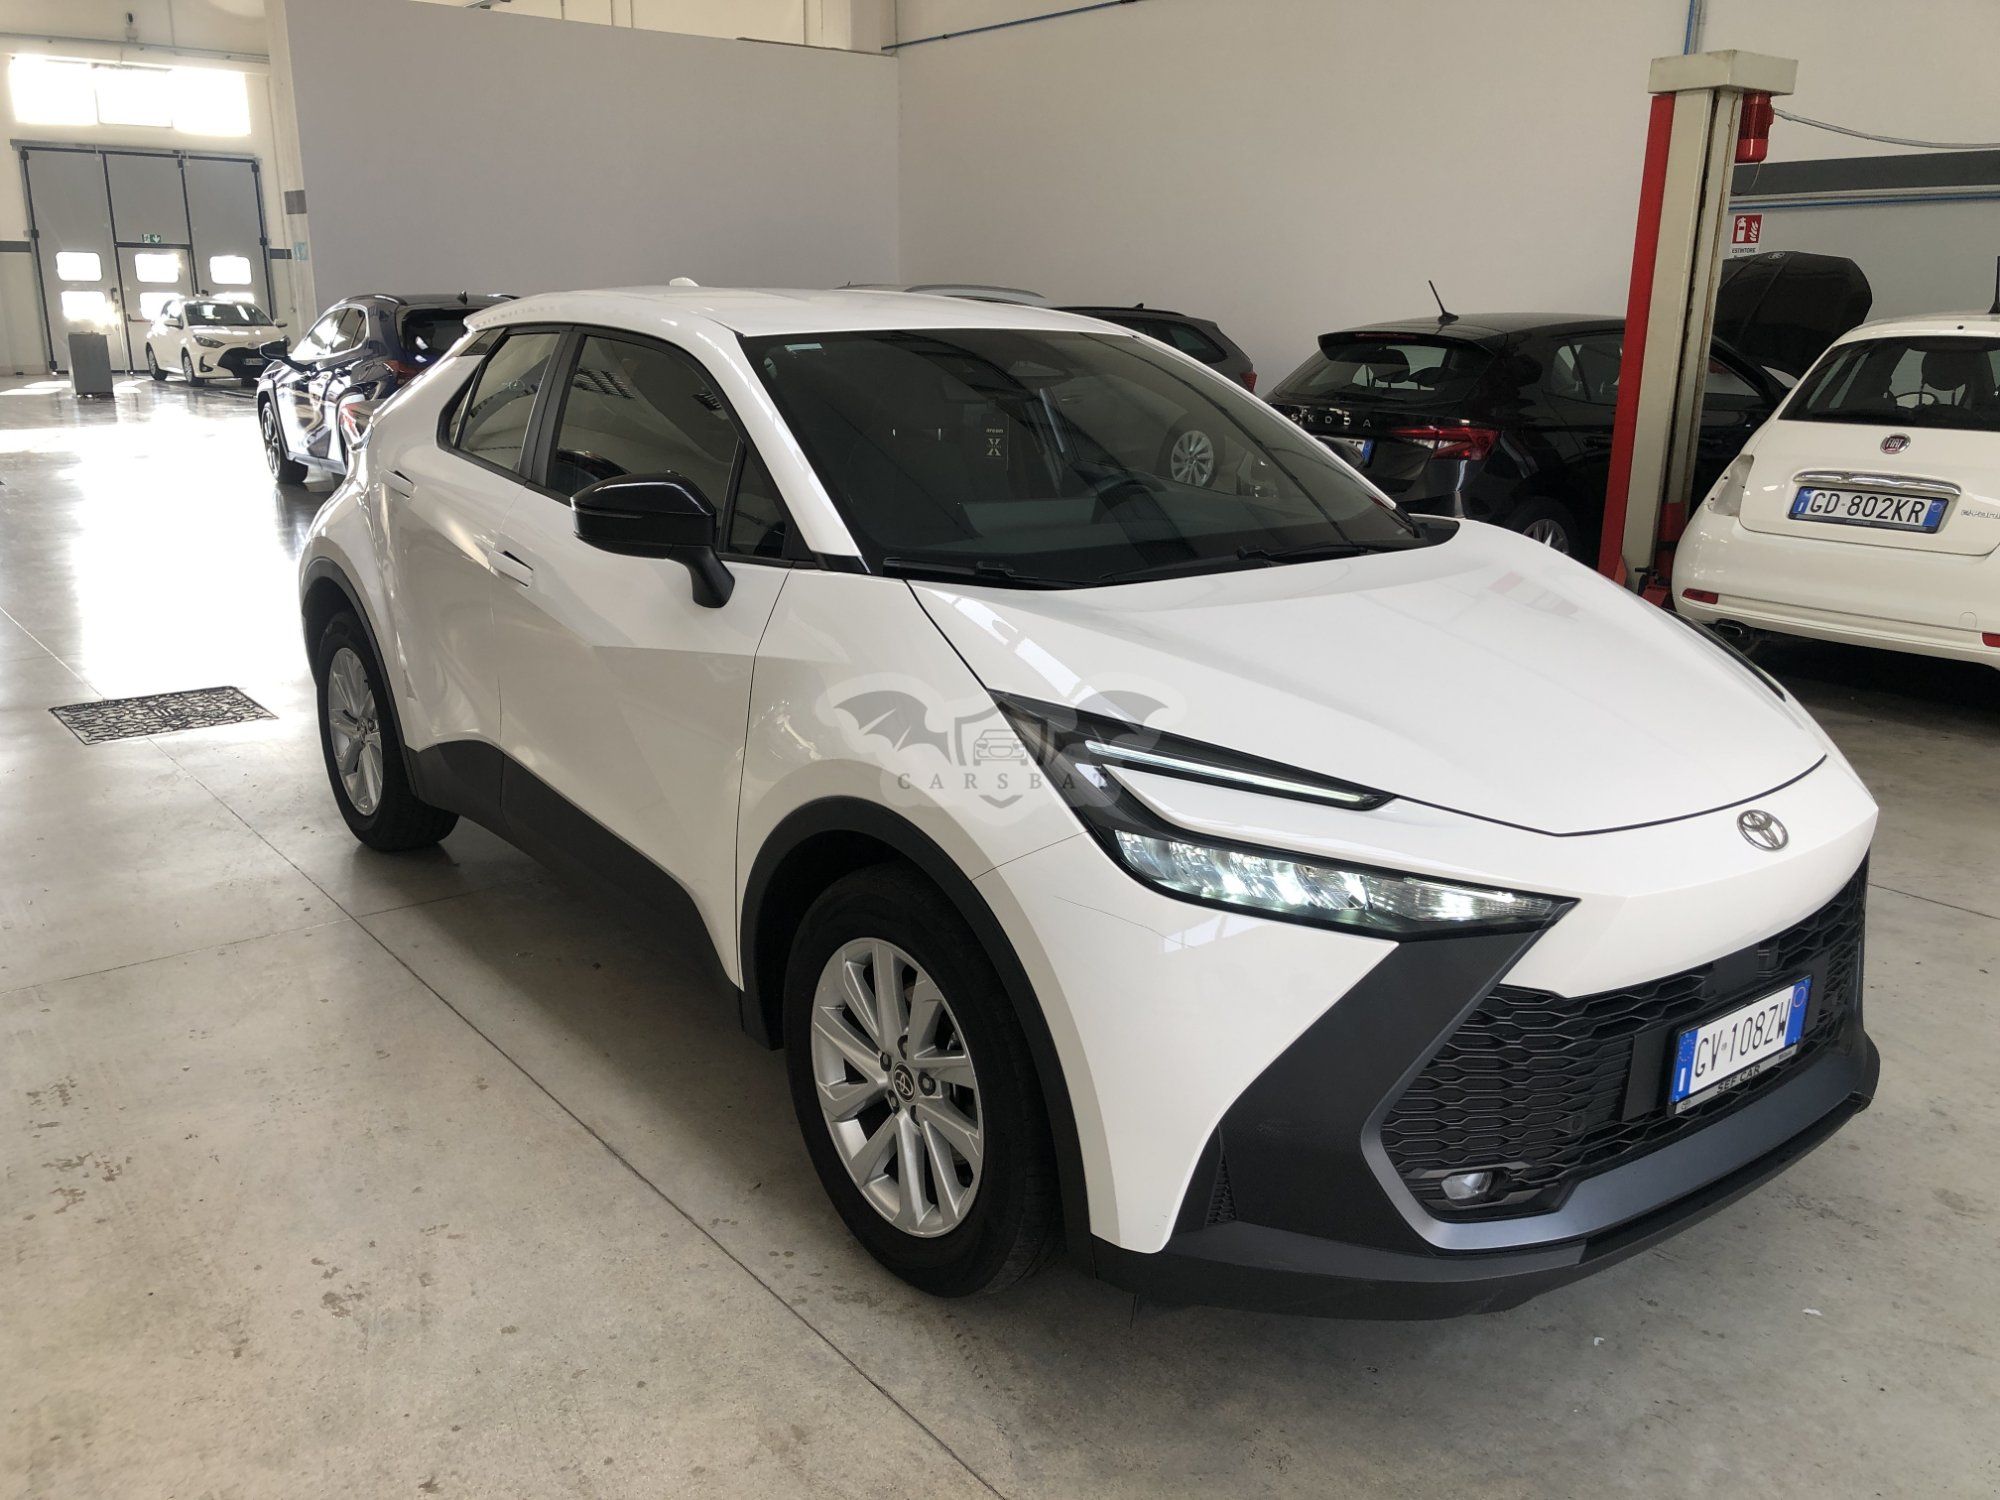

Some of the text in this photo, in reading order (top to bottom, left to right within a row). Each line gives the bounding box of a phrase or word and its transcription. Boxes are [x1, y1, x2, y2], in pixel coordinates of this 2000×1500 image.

[1847, 495, 1926, 523] 802KR
[1729, 998, 1791, 1062] 108ZW
[1717, 1064, 1761, 1094] SEF CAR
